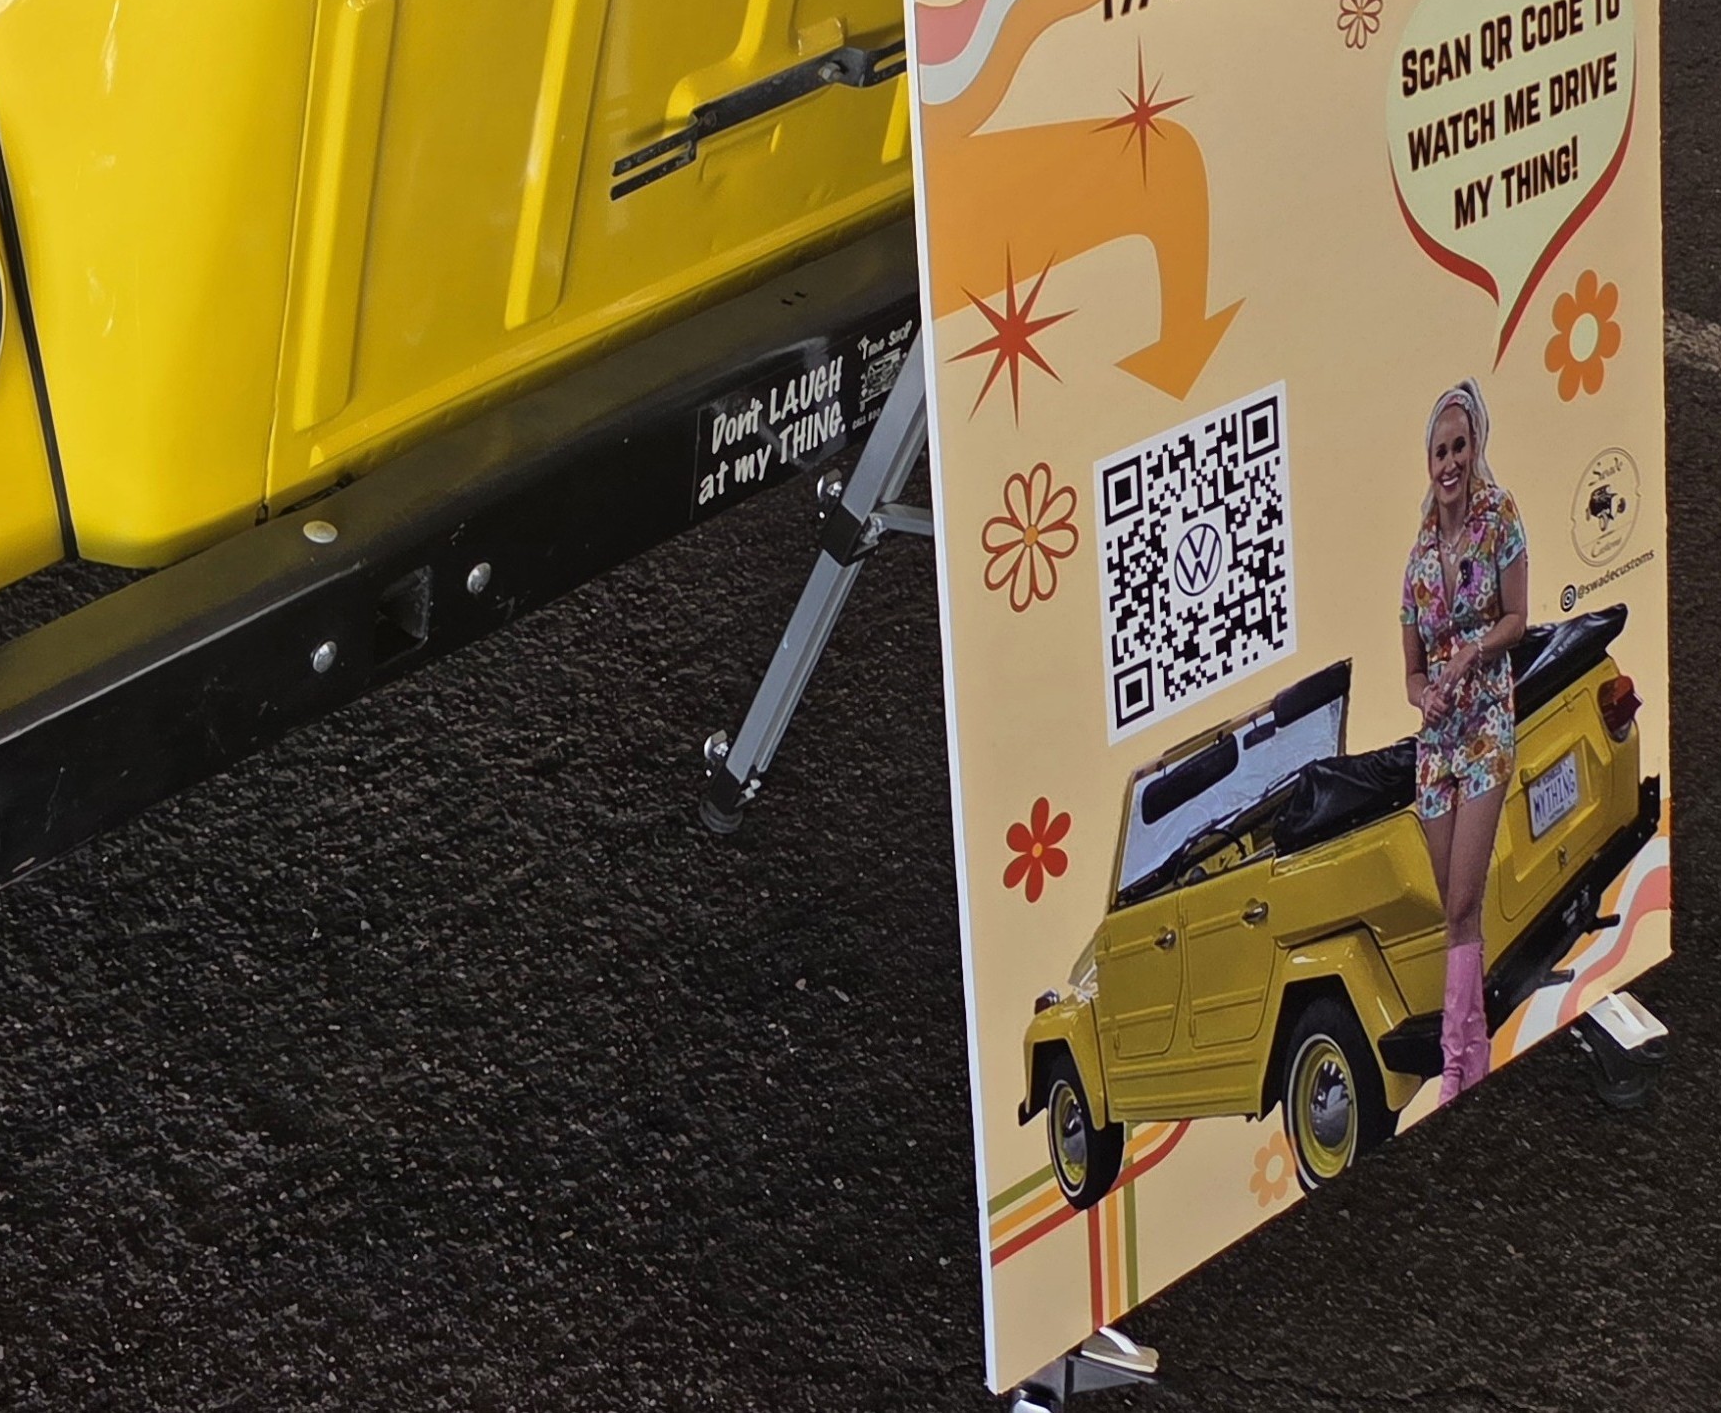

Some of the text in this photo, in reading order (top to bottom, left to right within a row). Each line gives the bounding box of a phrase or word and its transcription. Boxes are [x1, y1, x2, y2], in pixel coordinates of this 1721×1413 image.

[1401, 37, 1474, 98] SCAN
[1480, 25, 1514, 74] QR
[1519, 1, 1585, 54] CODE
[1408, 53, 1619, 173] WATCH ME DRIVE
[1453, 136, 1580, 232] MY THING!
[698, 400, 846, 506] at my THING.
[711, 355, 844, 455] Don't LAUGH
[1577, 549, 1655, 600] @swadecustoms
